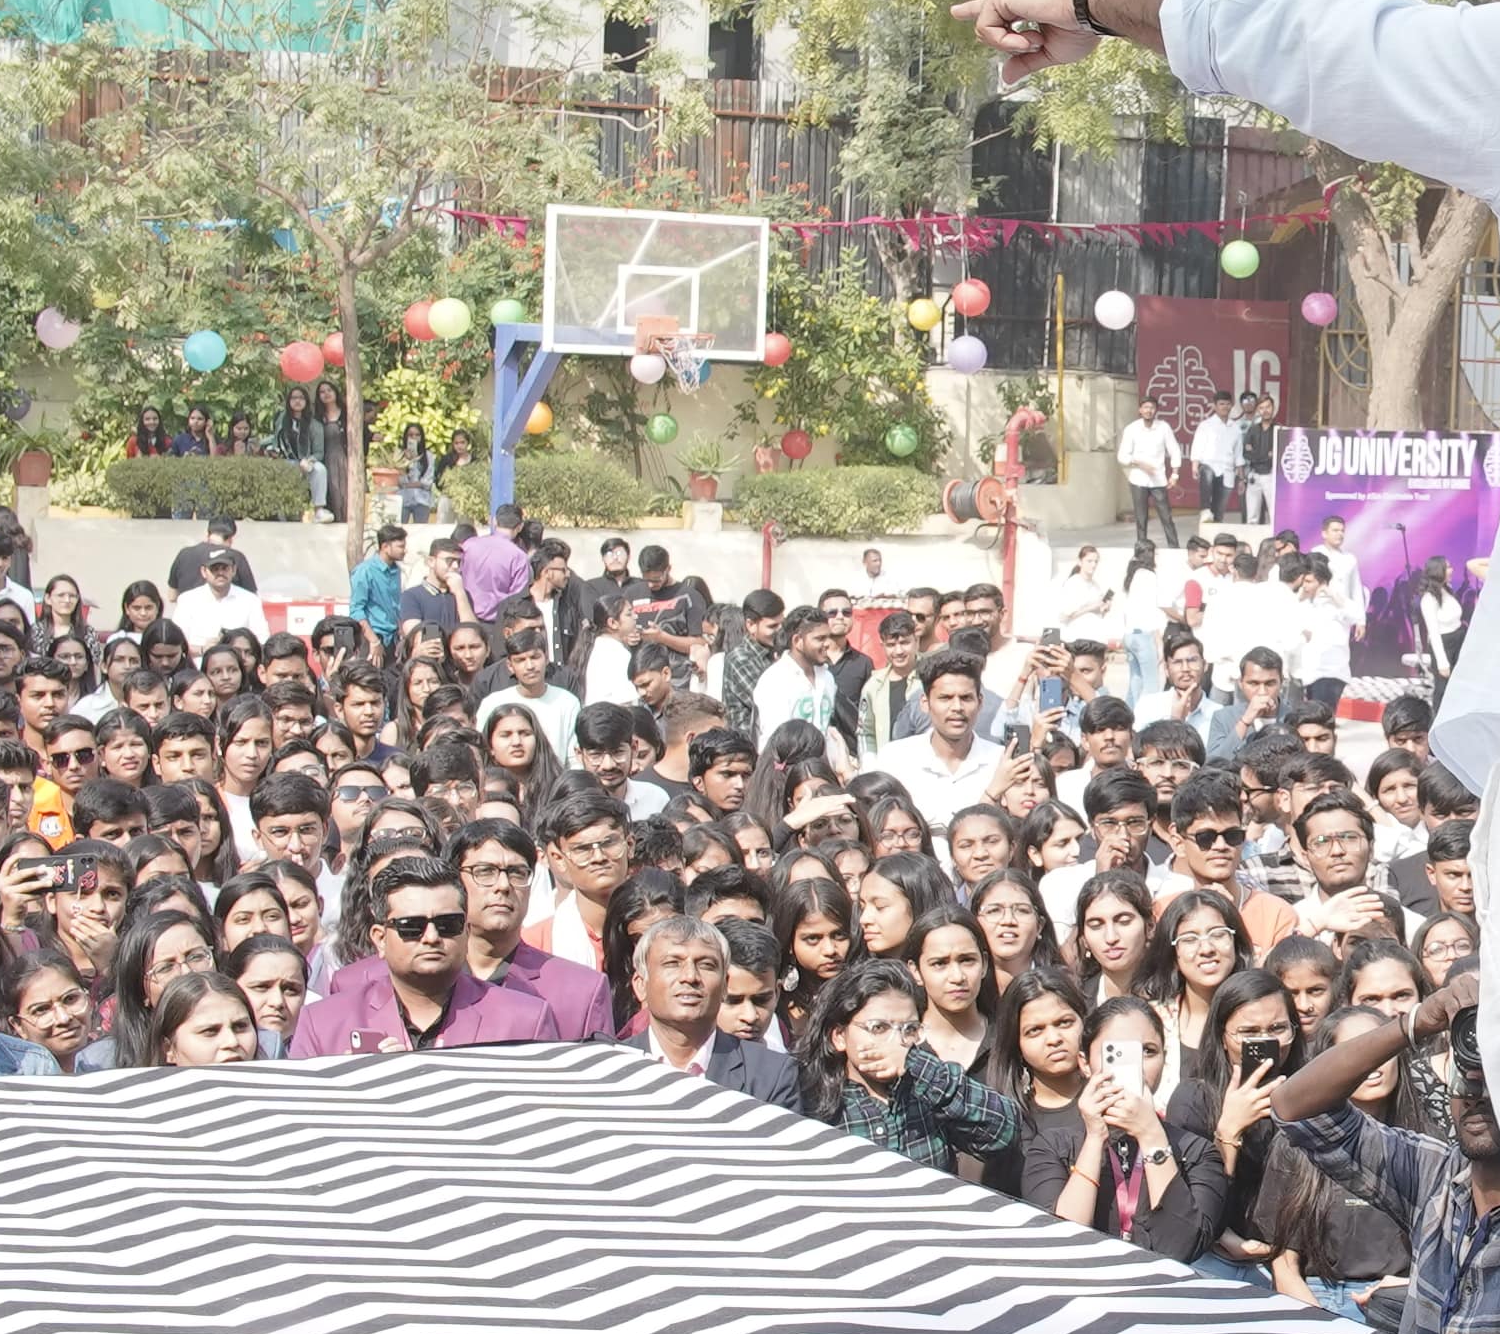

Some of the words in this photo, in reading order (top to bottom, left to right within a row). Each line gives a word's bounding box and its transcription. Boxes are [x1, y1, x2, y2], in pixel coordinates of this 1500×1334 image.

[1228, 348, 1281, 421] JG
[1315, 435, 1342, 476] JG
[1344, 436, 1477, 477] UNIVERSITY
